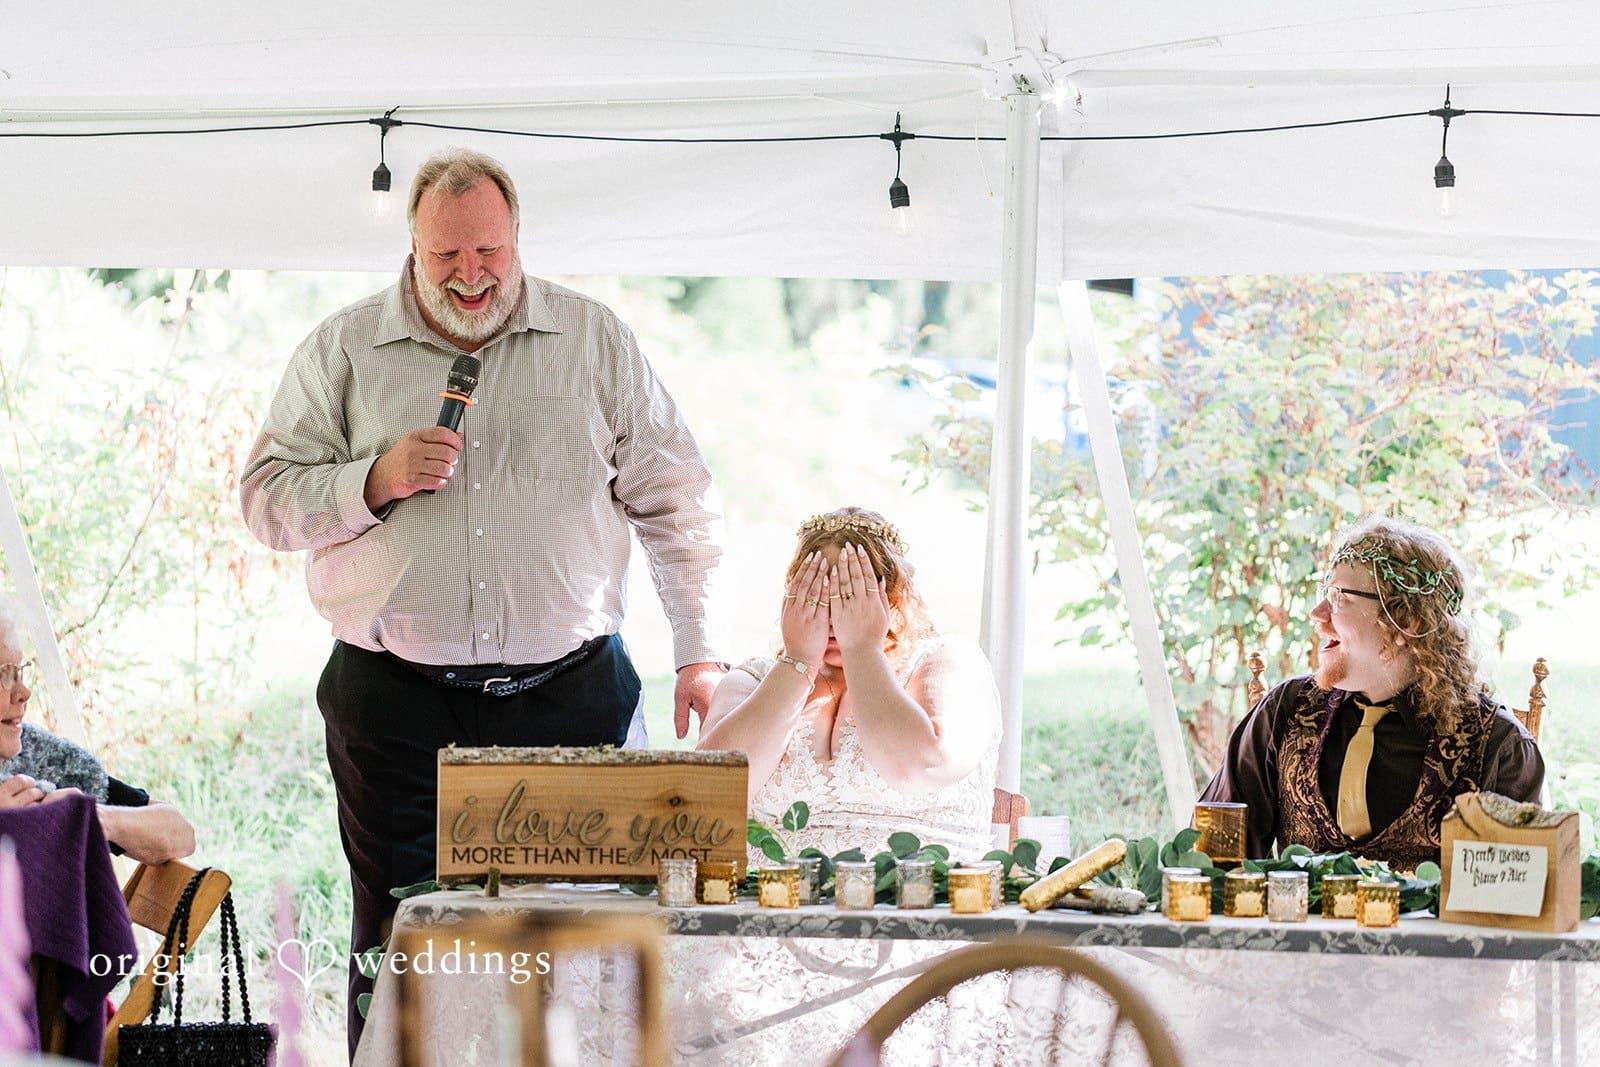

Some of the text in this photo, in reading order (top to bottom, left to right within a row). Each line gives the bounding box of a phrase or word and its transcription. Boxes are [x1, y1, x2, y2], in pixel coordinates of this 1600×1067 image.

[451, 778, 735, 866] i love you
[451, 846, 713, 865] MORE THAN THE MOST
